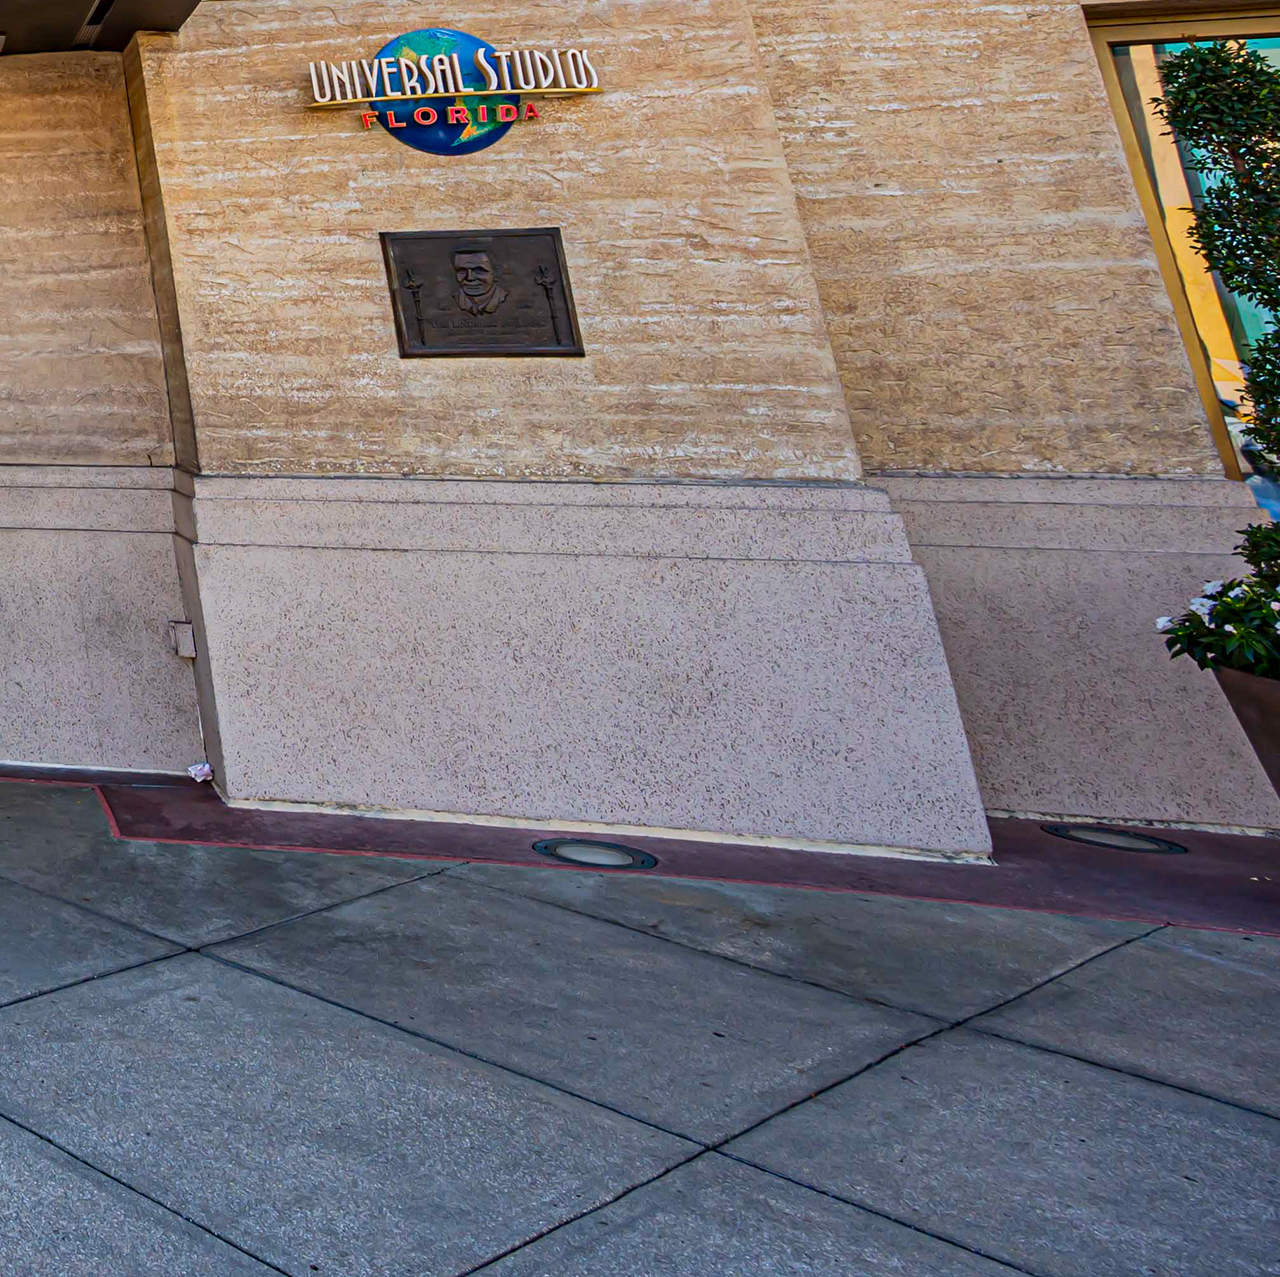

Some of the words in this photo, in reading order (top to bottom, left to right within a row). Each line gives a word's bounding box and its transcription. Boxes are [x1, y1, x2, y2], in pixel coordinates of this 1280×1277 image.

[308, 53, 474, 104] UNIVERSAL
[474, 47, 600, 92] STUDIOS
[360, 102, 543, 130] FLORIDA
